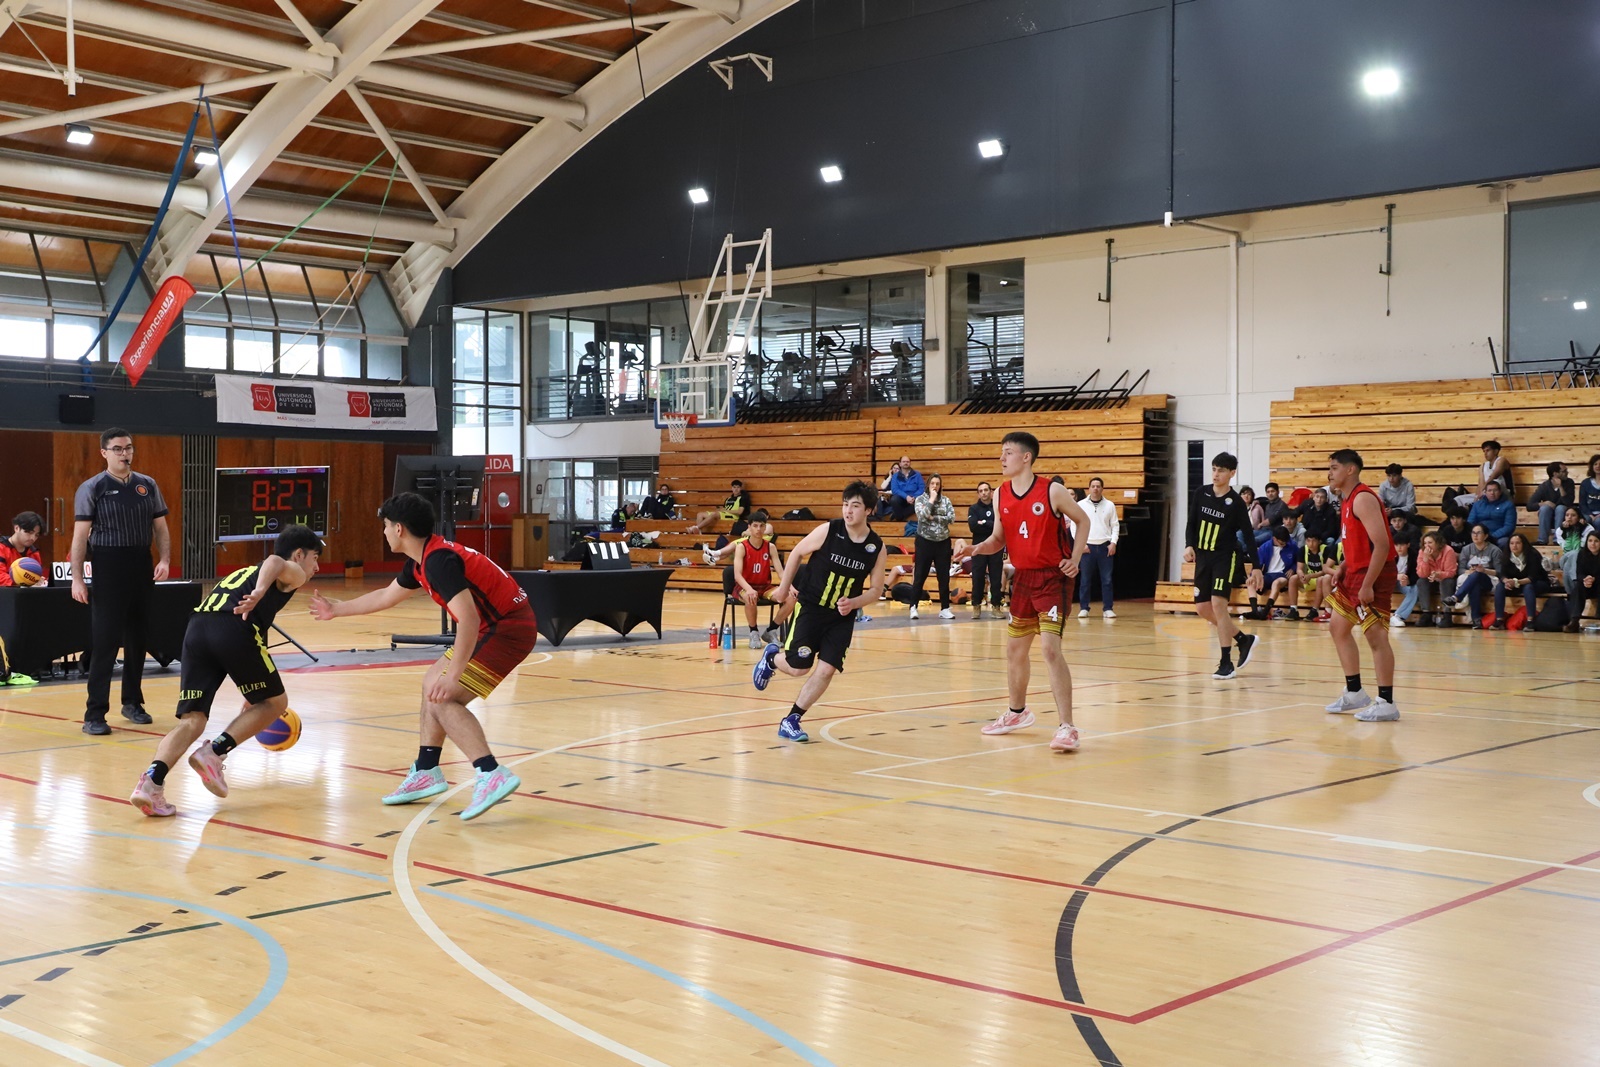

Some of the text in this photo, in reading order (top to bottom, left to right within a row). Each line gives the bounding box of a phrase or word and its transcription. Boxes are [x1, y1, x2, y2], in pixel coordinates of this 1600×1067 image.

[252, 479, 313, 512] 8:27
[1201, 506, 1226, 519] TEILLIER
[253, 515, 266, 536] 2
[1018, 521, 1029, 539] 4
[752, 563, 762, 574] 10
[830, 553, 866, 570] TEILLIER
[1213, 578, 1224, 591] 11
[1047, 605, 1059, 622] 4
